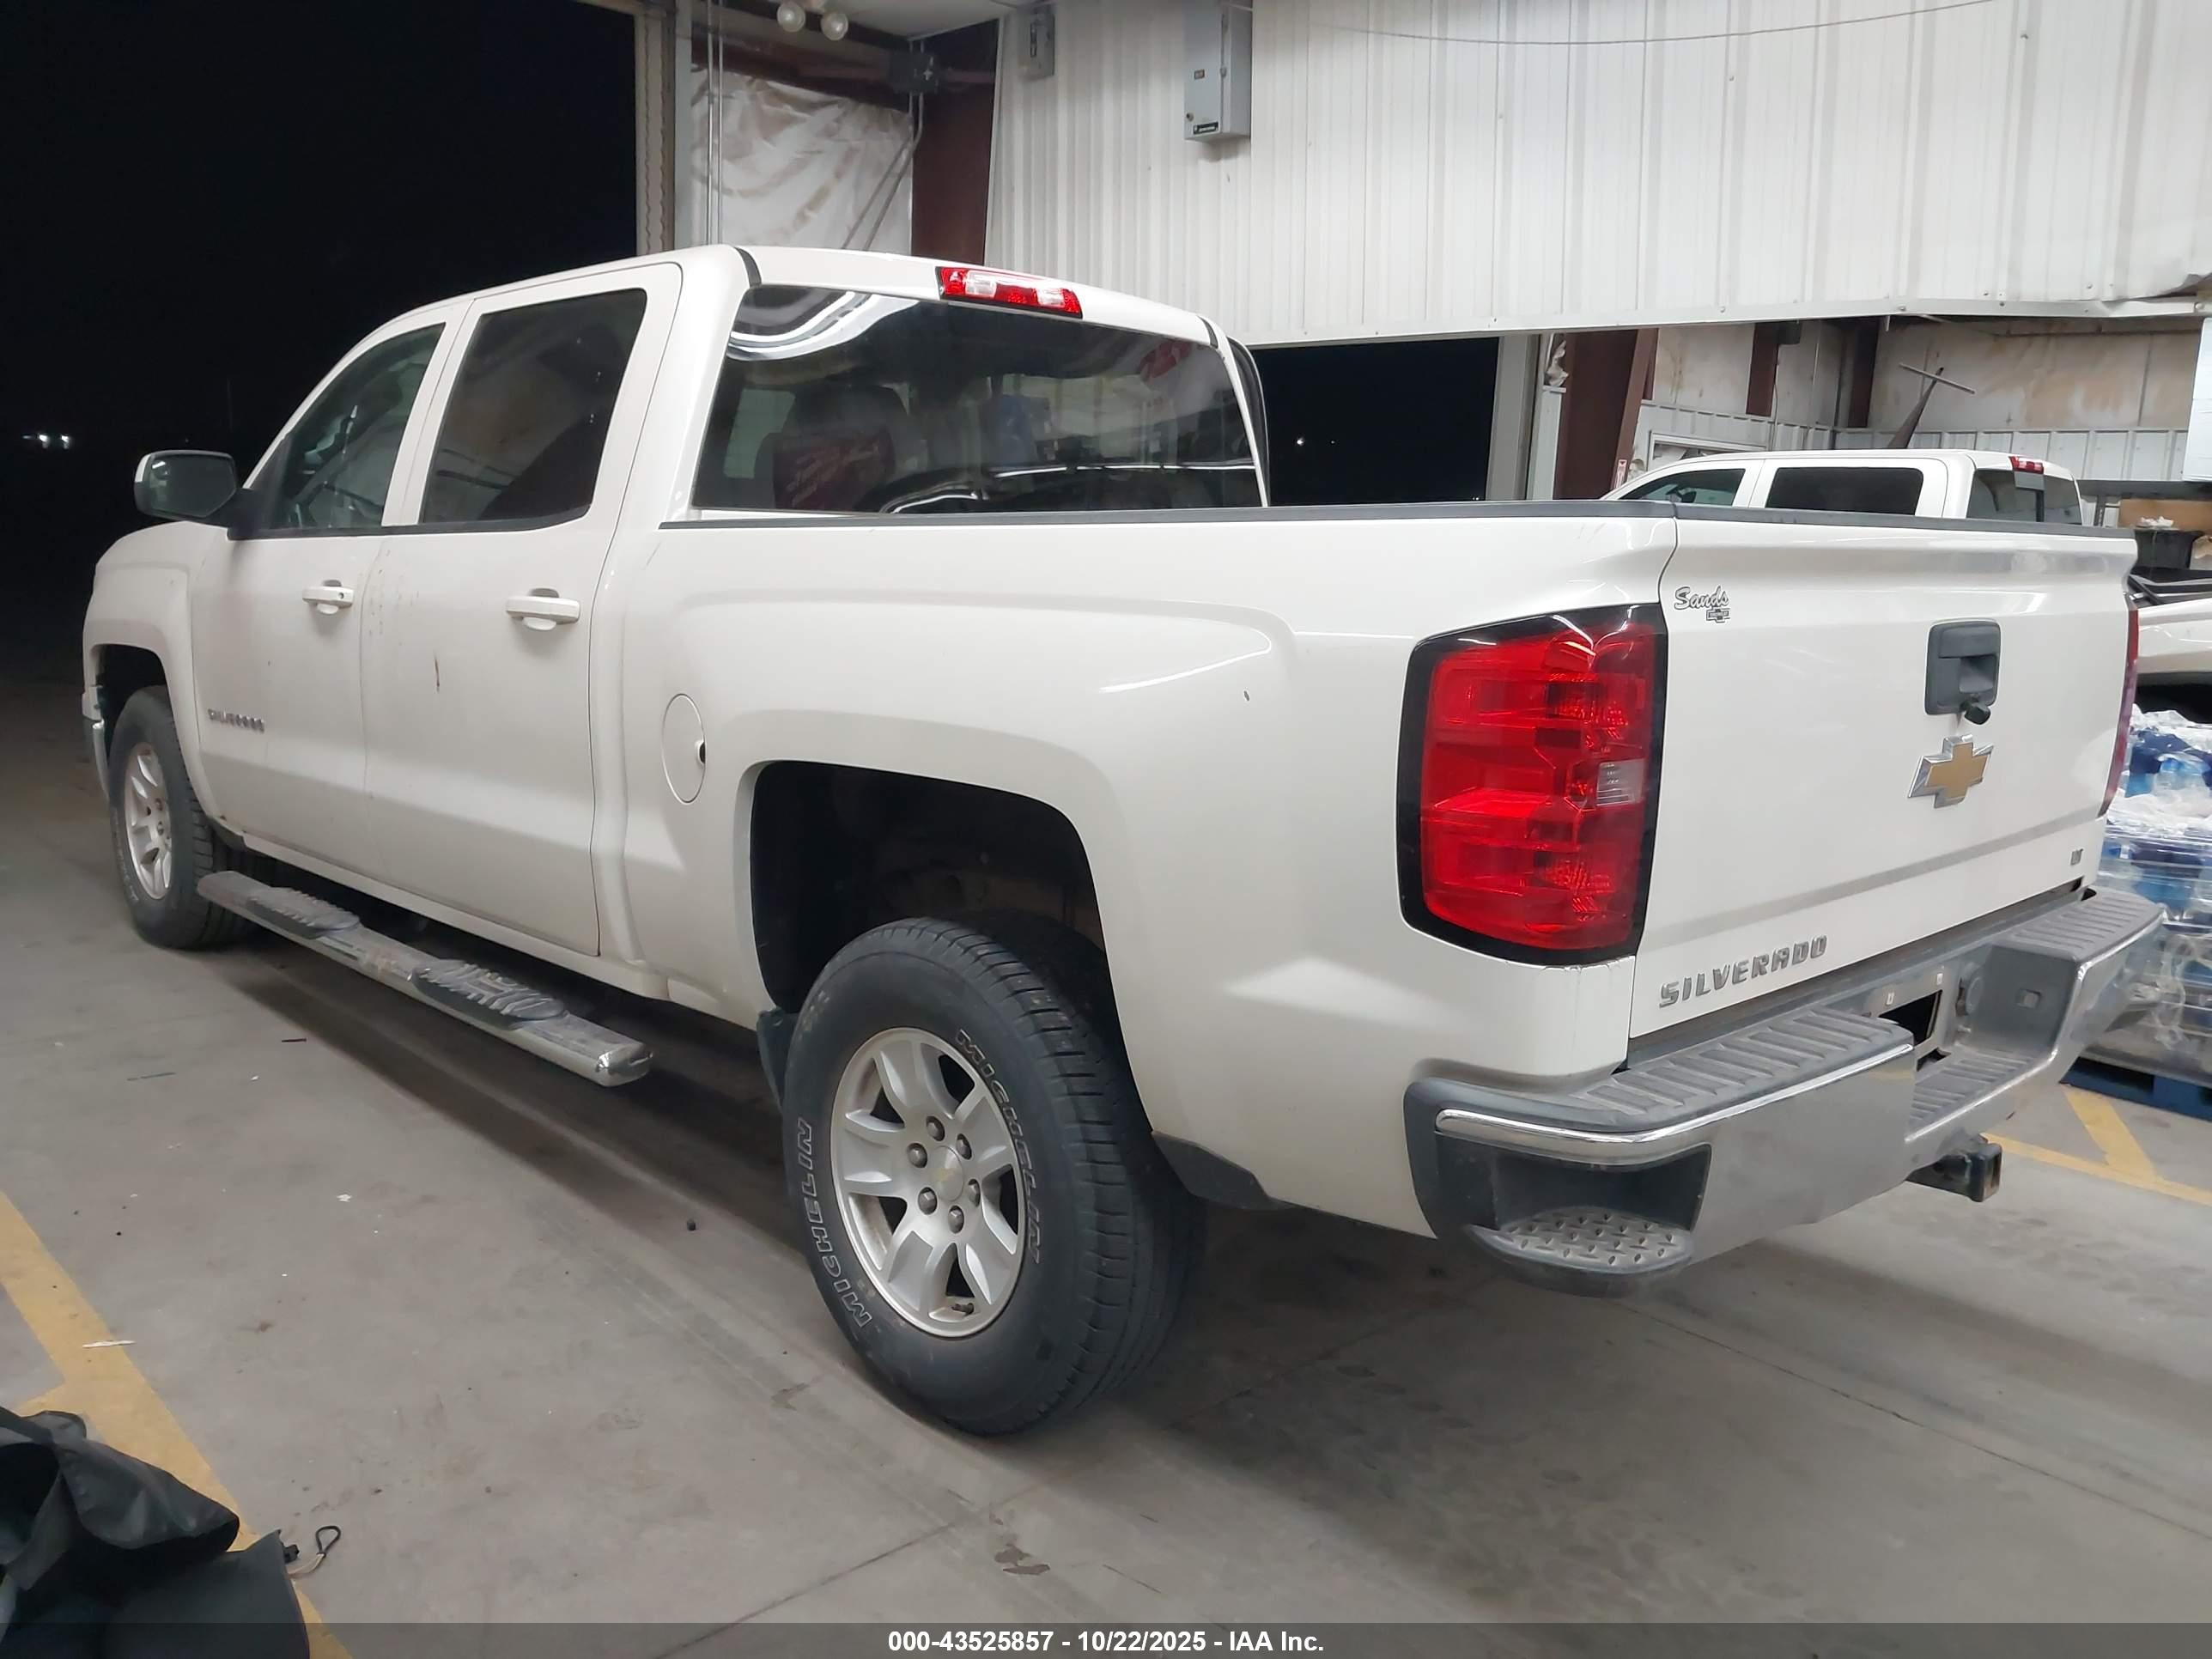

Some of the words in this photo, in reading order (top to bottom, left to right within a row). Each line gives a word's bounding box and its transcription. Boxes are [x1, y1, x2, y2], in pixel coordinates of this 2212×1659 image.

[1674, 585, 1729, 610] Sands
[1659, 934, 1828, 1008] SILVERADO
[797, 1116, 872, 1328] MICHELIN
